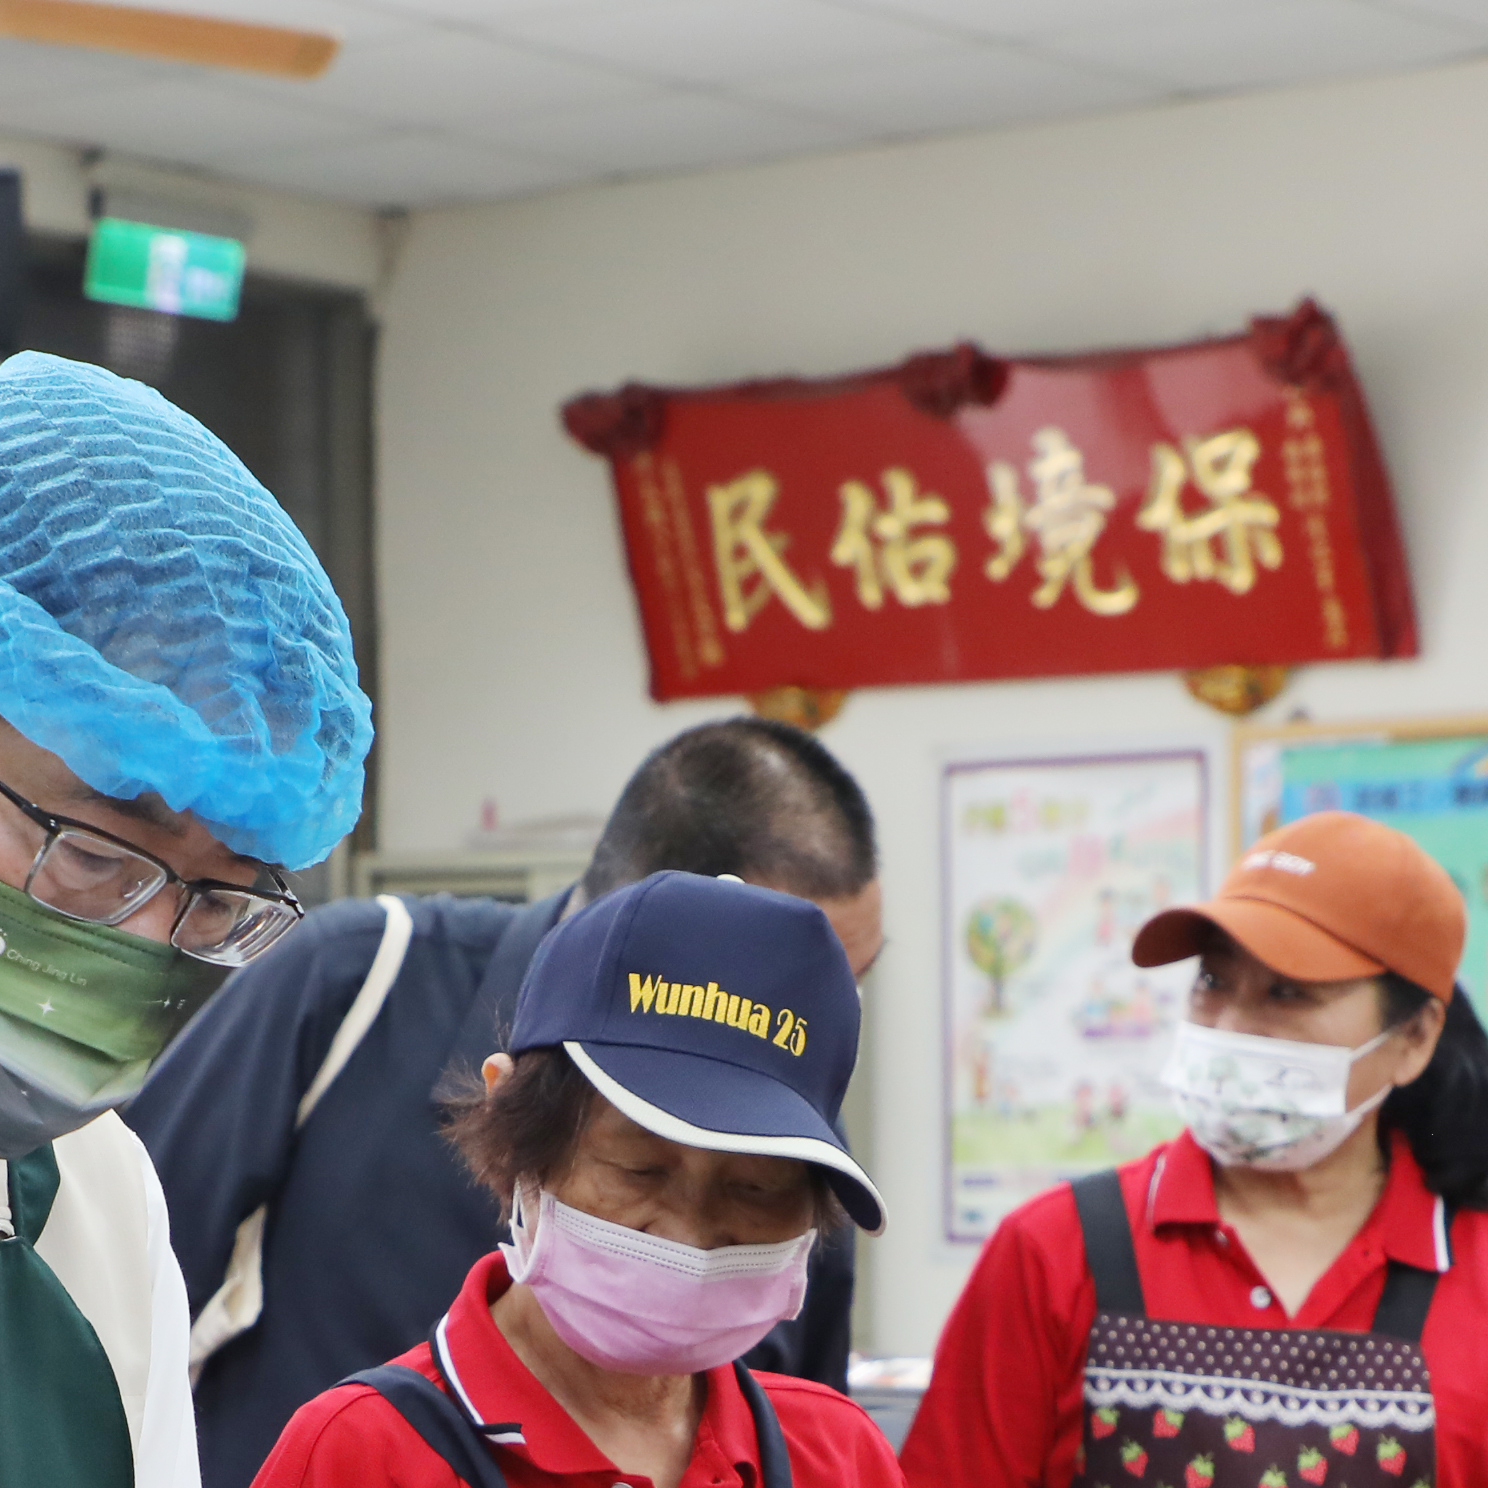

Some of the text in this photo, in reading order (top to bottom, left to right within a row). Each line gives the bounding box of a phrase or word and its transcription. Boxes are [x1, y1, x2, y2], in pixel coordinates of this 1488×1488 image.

[6, 948, 40, 971] Ching
[628, 972, 809, 1057] Wunhua 25
